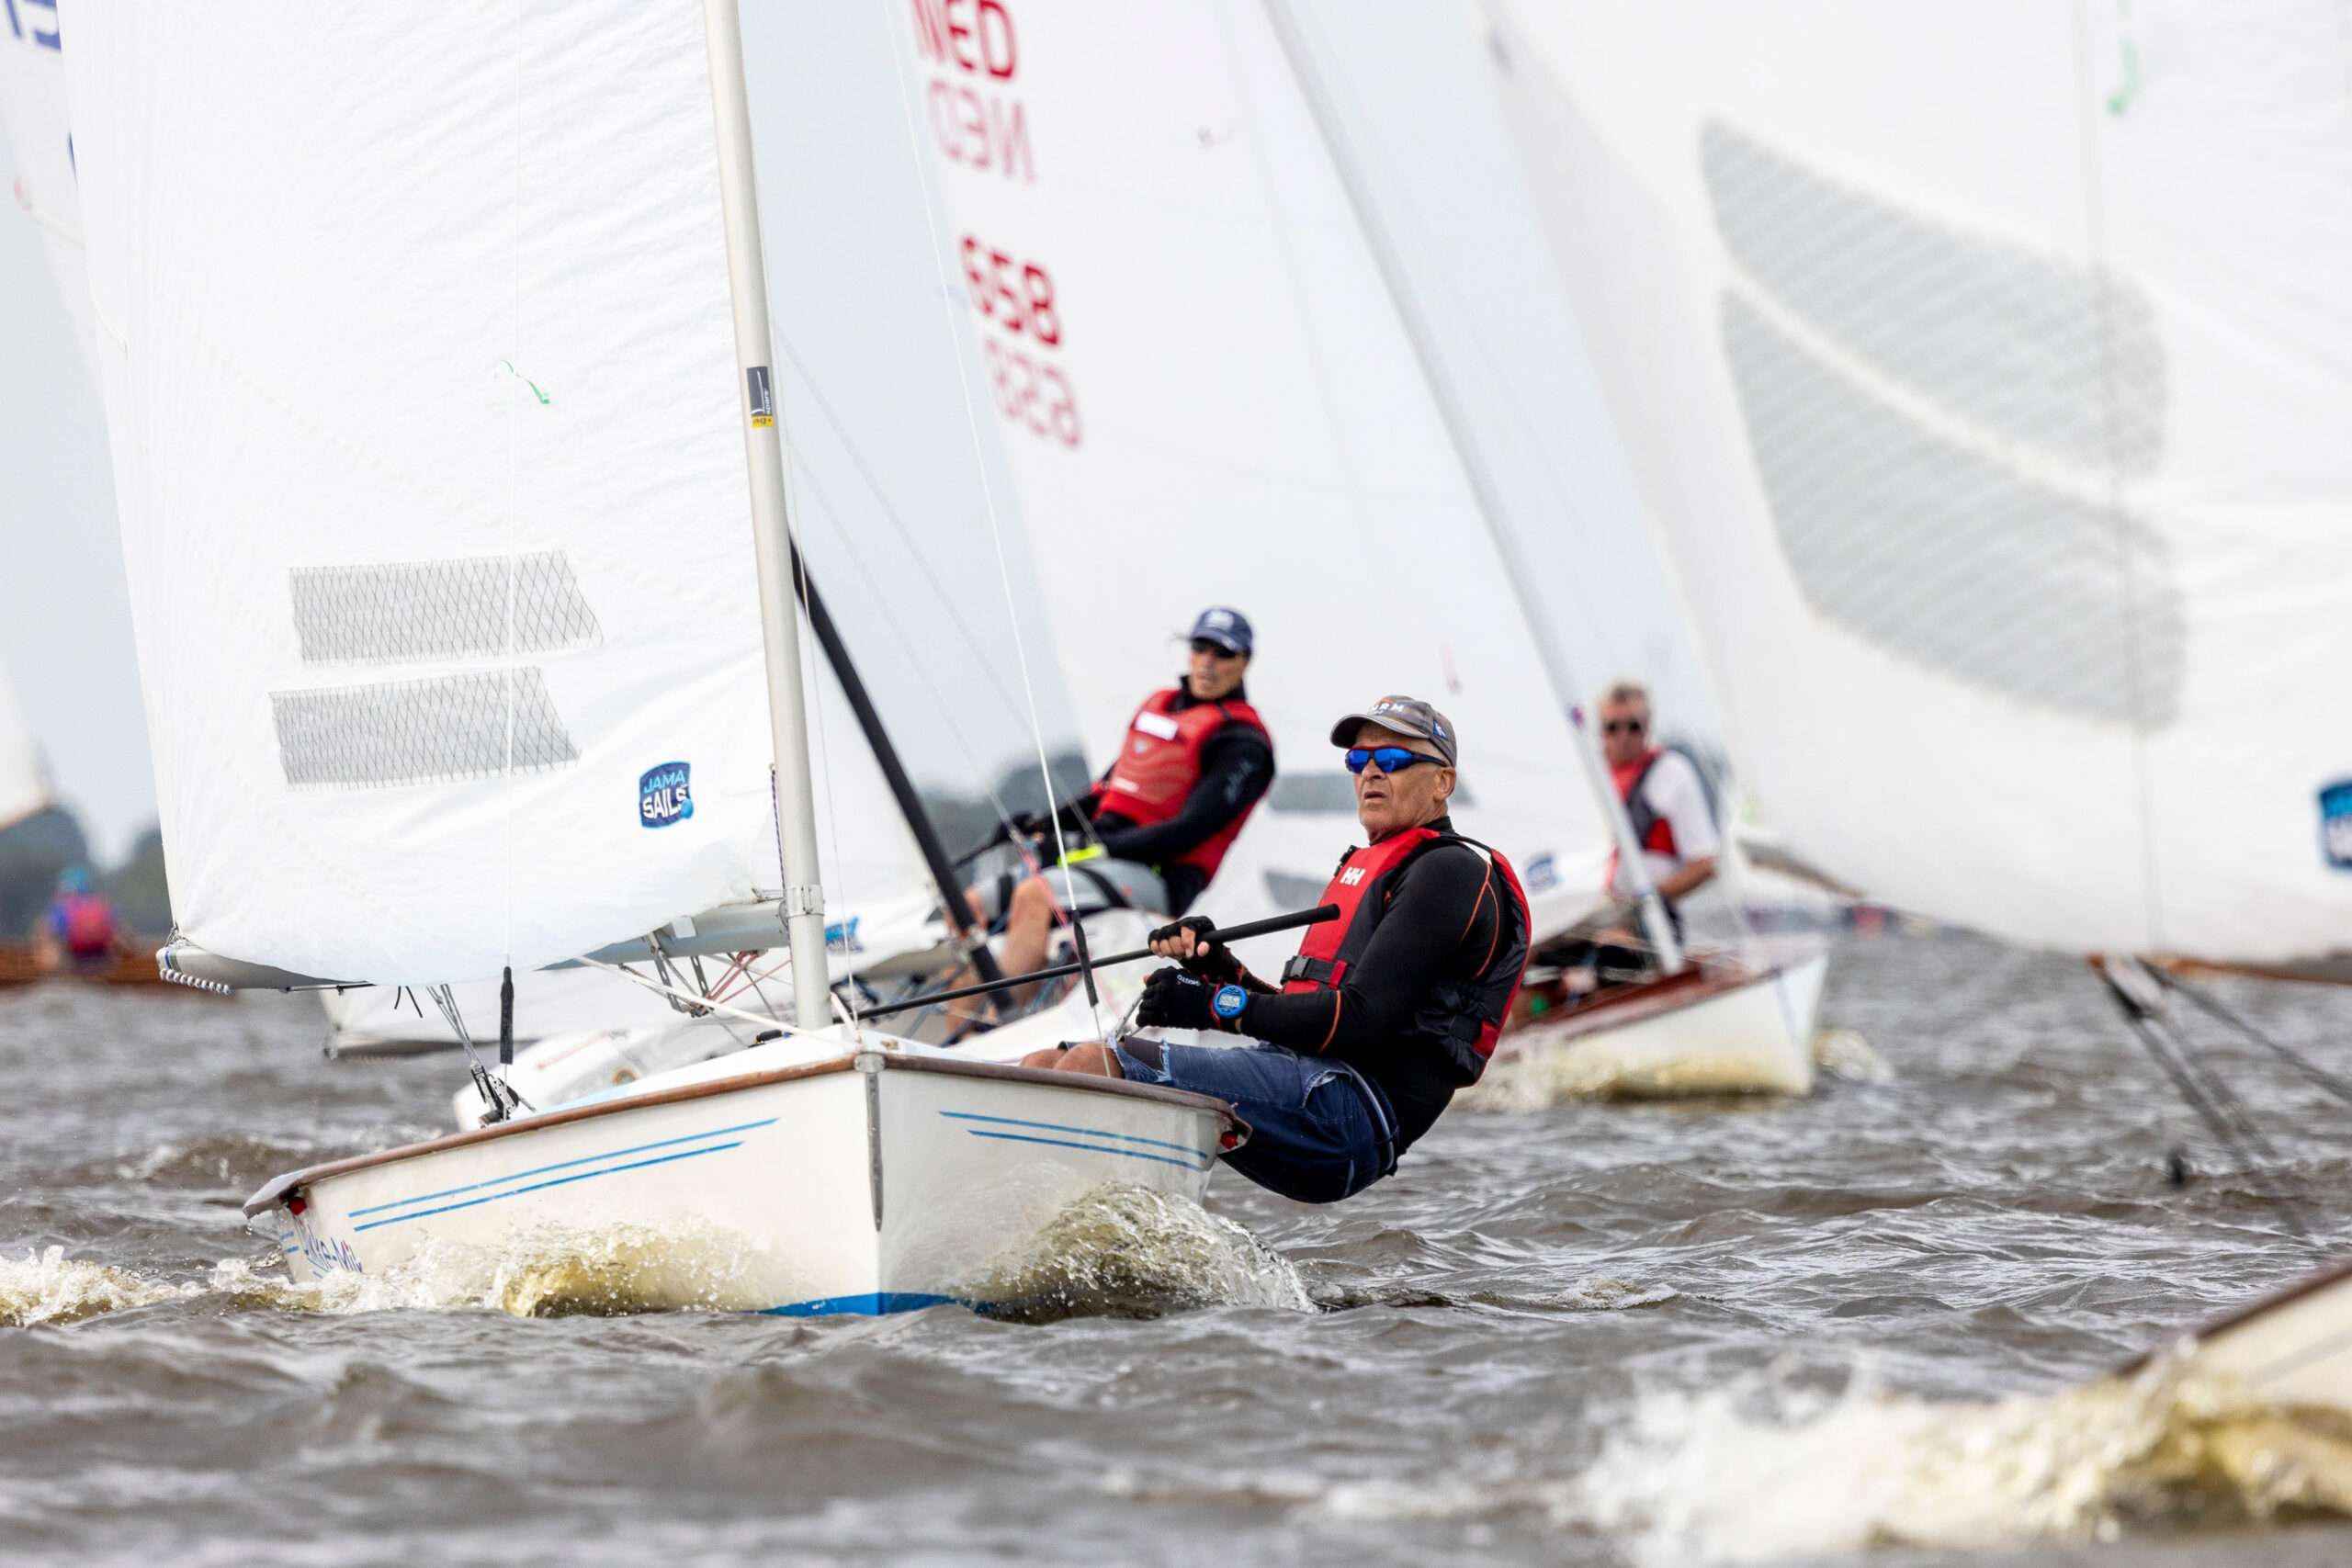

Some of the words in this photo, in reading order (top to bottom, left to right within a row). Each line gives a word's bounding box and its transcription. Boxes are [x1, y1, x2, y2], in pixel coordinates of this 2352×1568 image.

[911, 0, 1018, 81] NED
[960, 234, 1063, 349] 658
[643, 770, 685, 794] JAMA
[642, 784, 689, 818] SAILS
[1340, 866, 1366, 886] HH
